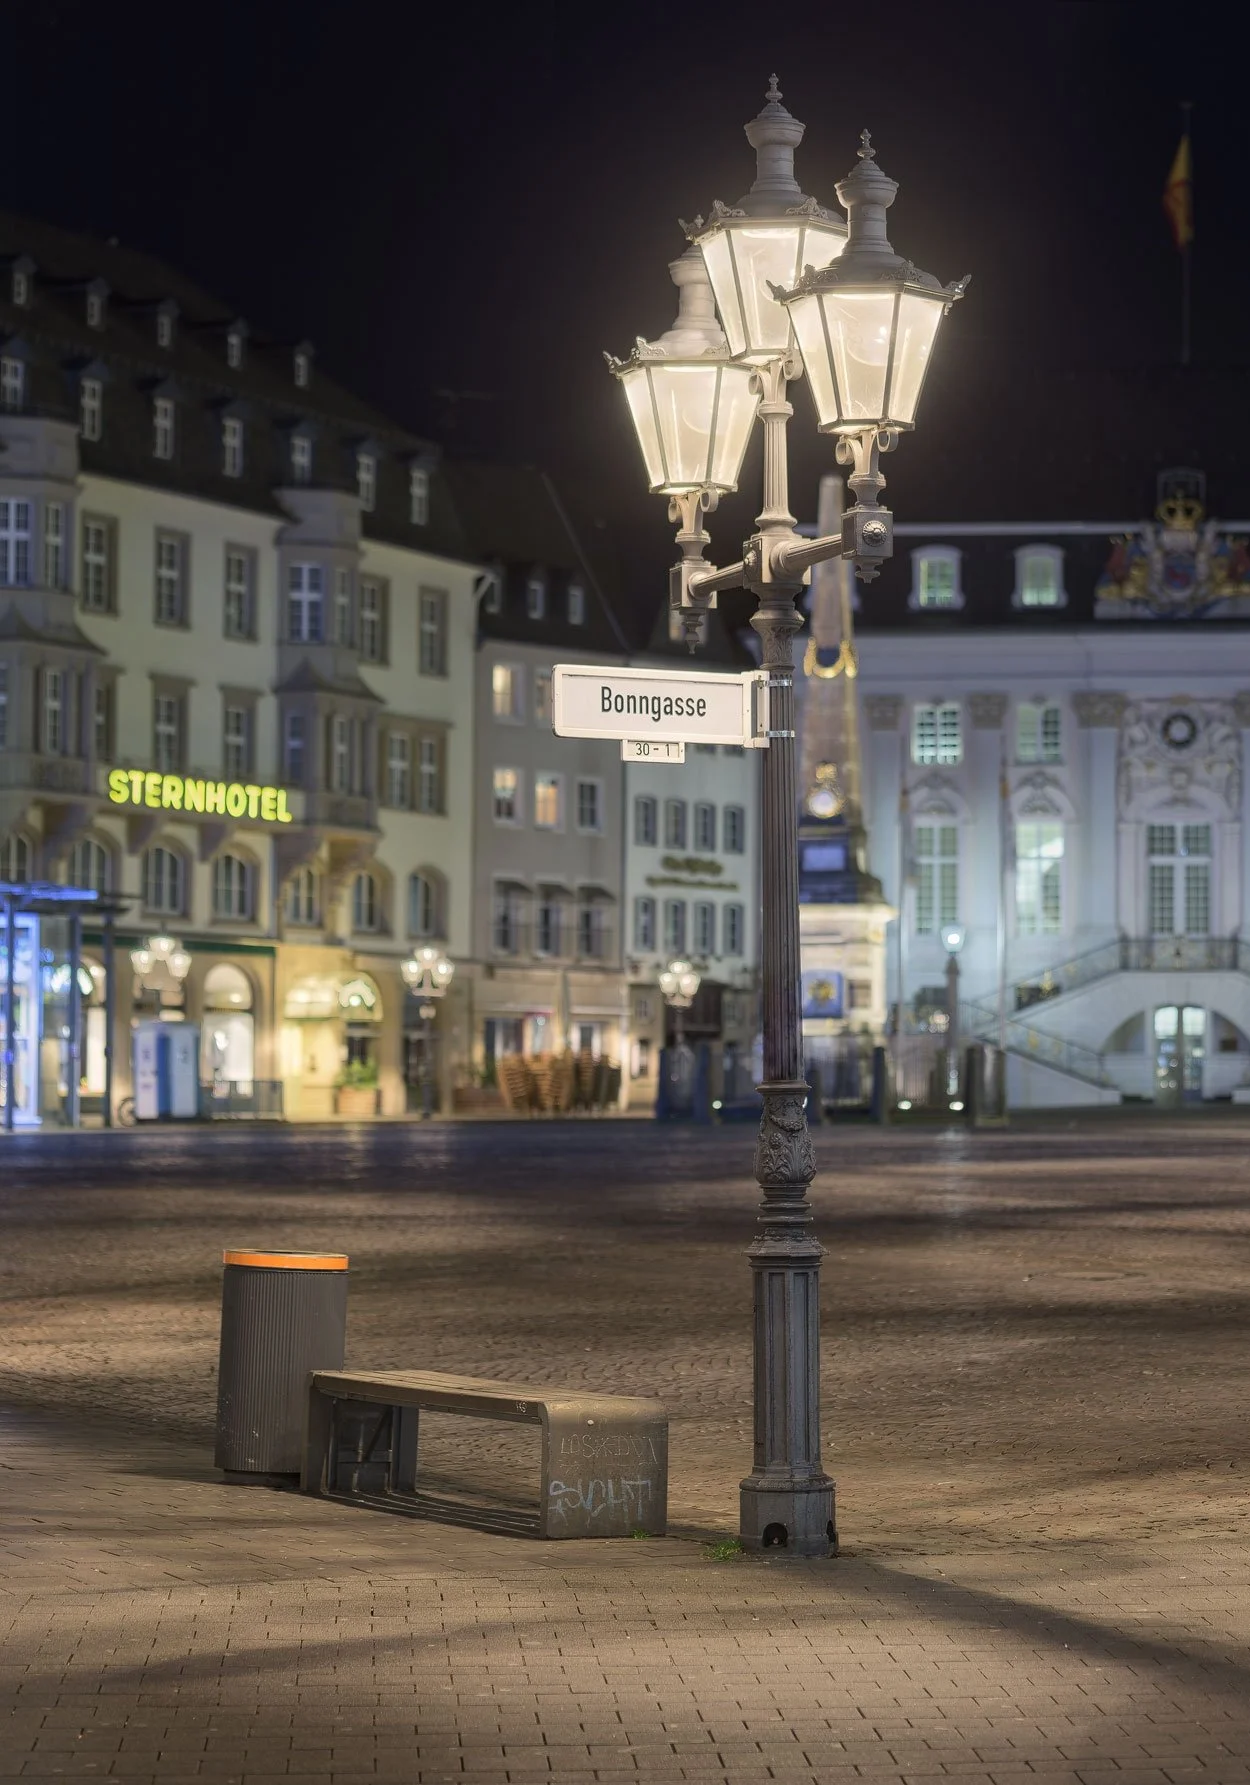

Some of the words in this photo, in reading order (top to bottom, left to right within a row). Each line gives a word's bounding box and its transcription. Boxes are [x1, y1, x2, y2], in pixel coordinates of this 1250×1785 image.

[601, 686, 706, 722] Bonngasse
[635, 743, 649, 756] 30
[665, 744, 670, 756] 1
[108, 769, 292, 823] STERNHOTEL
